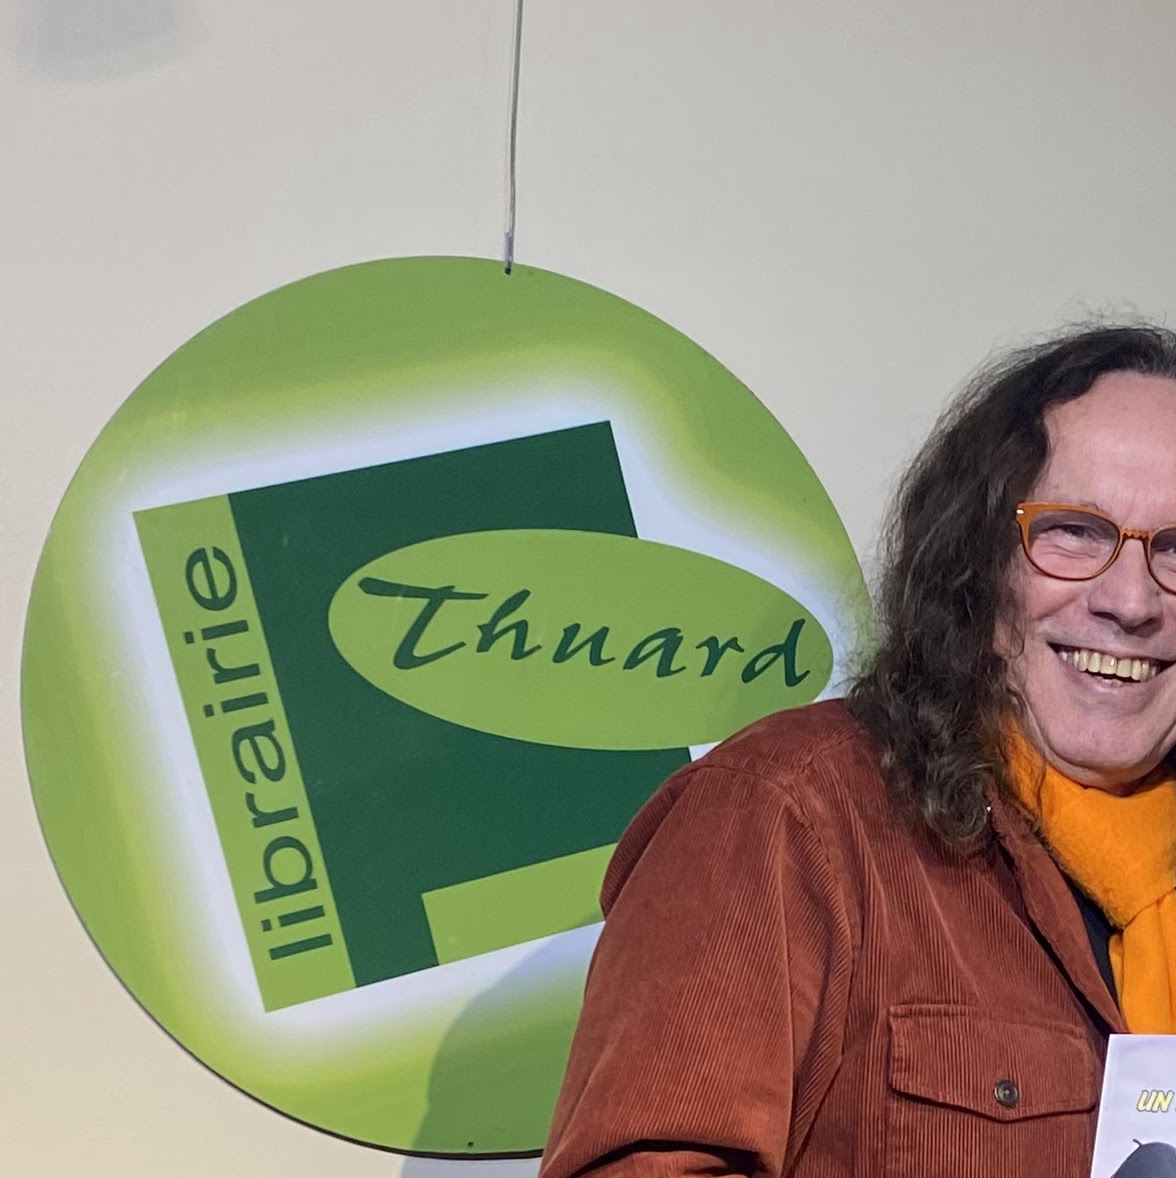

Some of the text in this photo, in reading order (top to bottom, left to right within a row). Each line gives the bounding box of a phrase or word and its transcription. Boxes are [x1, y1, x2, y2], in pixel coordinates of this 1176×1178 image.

[357, 576, 811, 688] Thuard
[184, 546, 333, 961] librairie
[1136, 1089, 1174, 1113] UN
